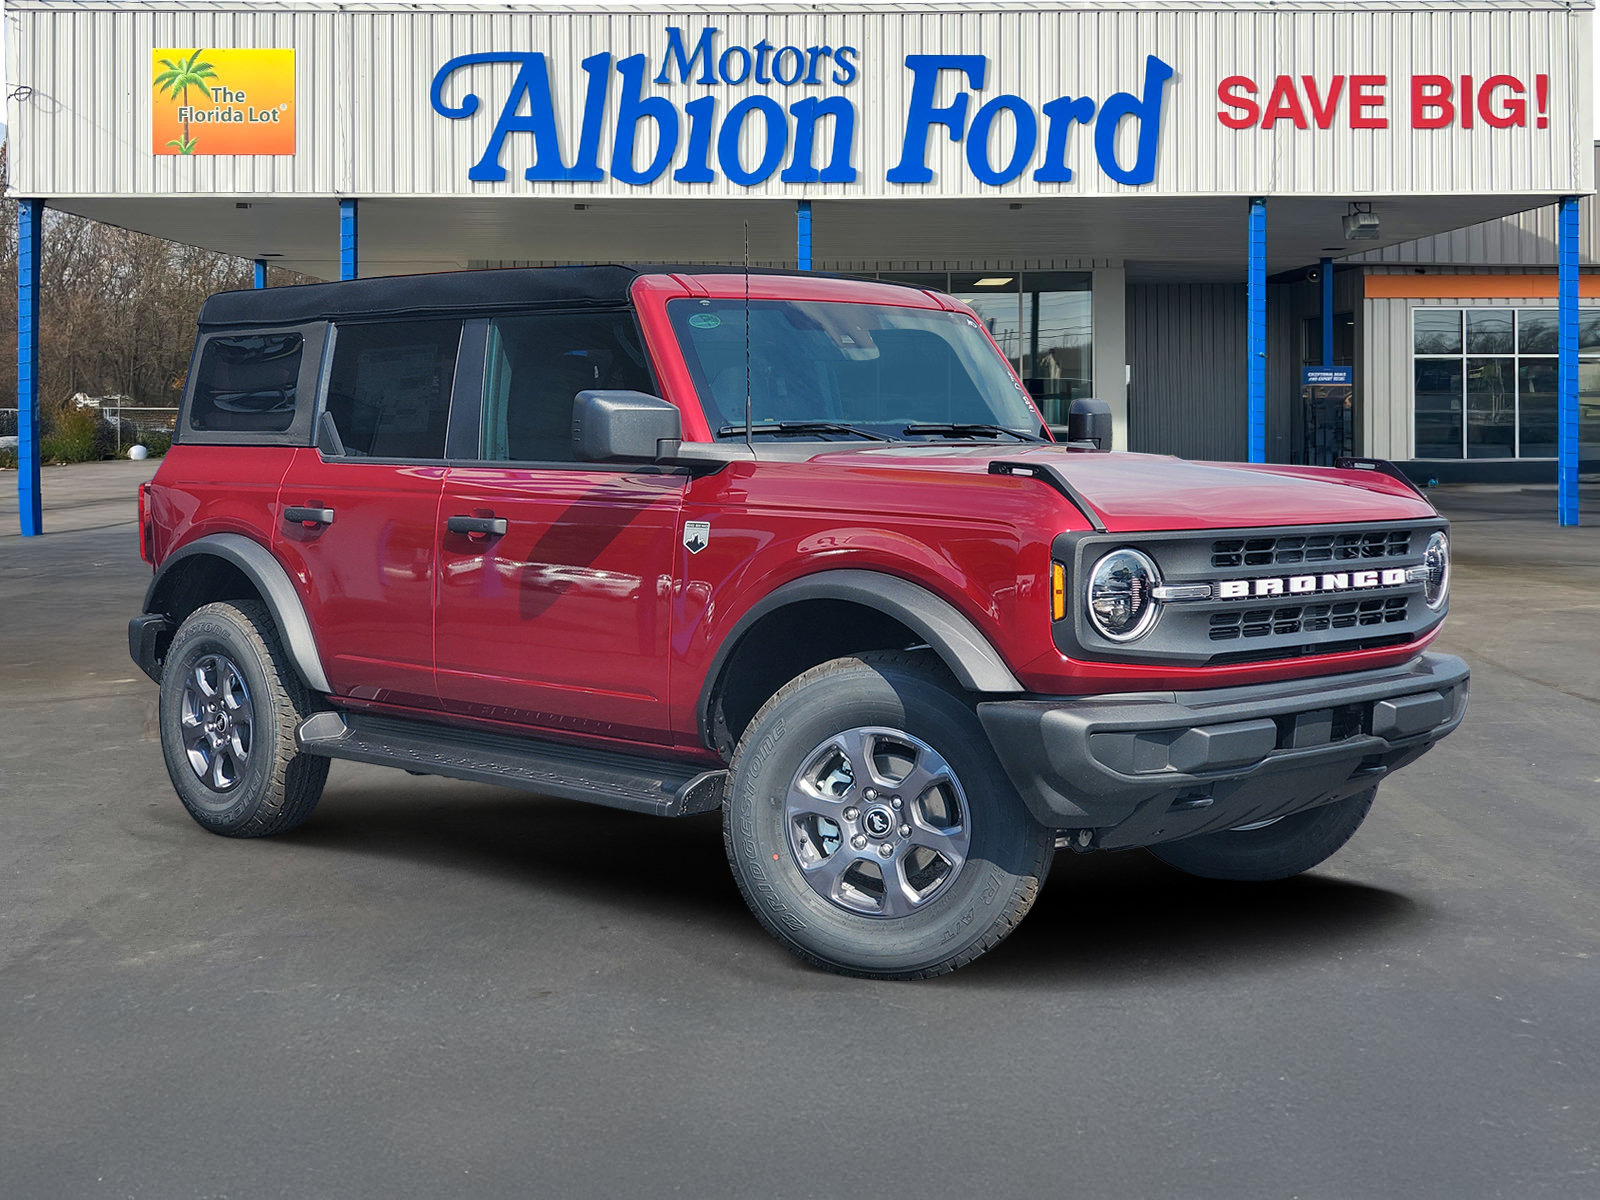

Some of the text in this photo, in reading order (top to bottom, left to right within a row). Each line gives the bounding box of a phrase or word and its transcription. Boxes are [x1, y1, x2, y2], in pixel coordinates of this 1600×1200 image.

[653, 28, 856, 85] Motors
[177, 107, 243, 123] Florida
[211, 87, 246, 103] The
[430, 52, 1174, 186] Albion Ford
[1217, 75, 1548, 129] SAVE BIG!
[1219, 569, 1405, 598] BRONCO
[740, 718, 807, 932] BRIDGESTONE
